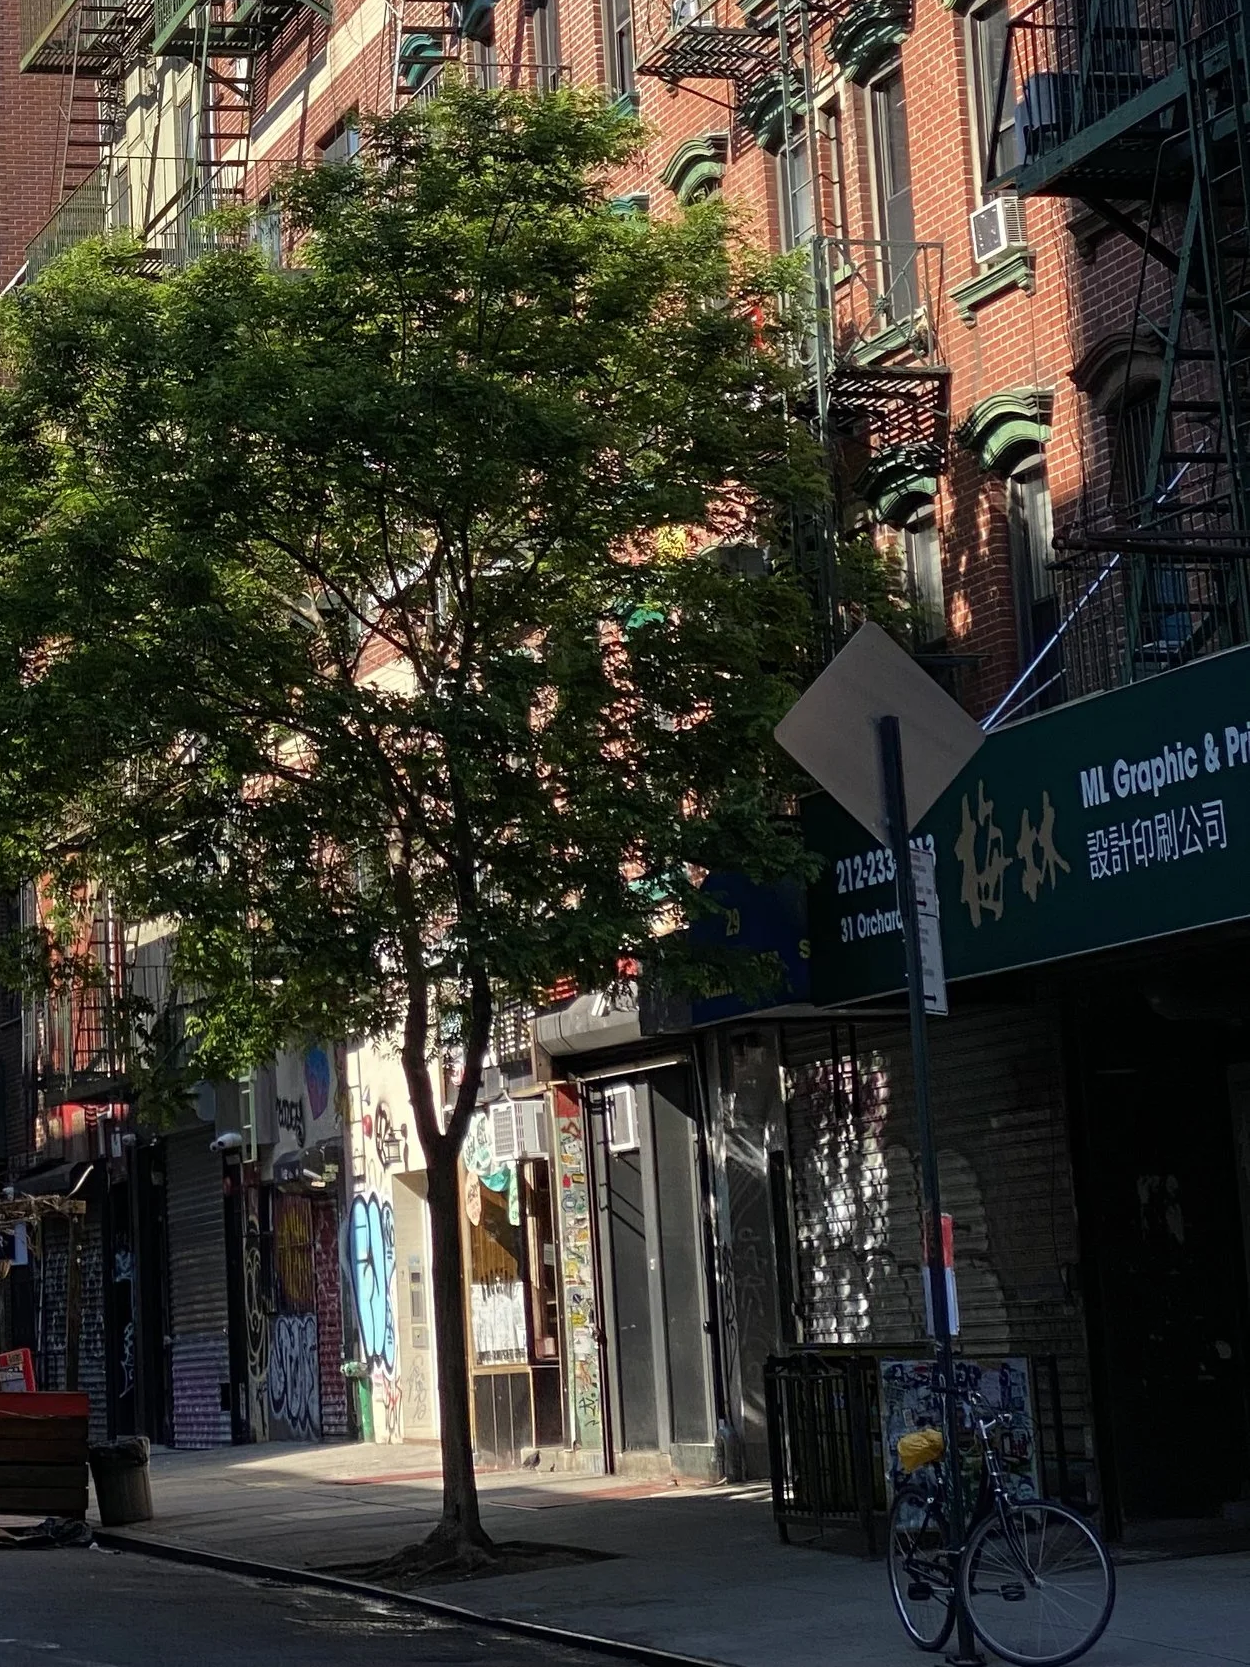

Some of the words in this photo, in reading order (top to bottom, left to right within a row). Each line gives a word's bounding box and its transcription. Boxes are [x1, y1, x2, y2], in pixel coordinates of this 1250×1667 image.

[1080, 765, 1111, 809] ML
[1113, 741, 1199, 798] Graphic
[1204, 732, 1222, 774] &
[1086, 799, 1228, 881] 設計印刷公司
[840, 916, 855, 943] 31
[857, 908, 904, 940] Orchard
